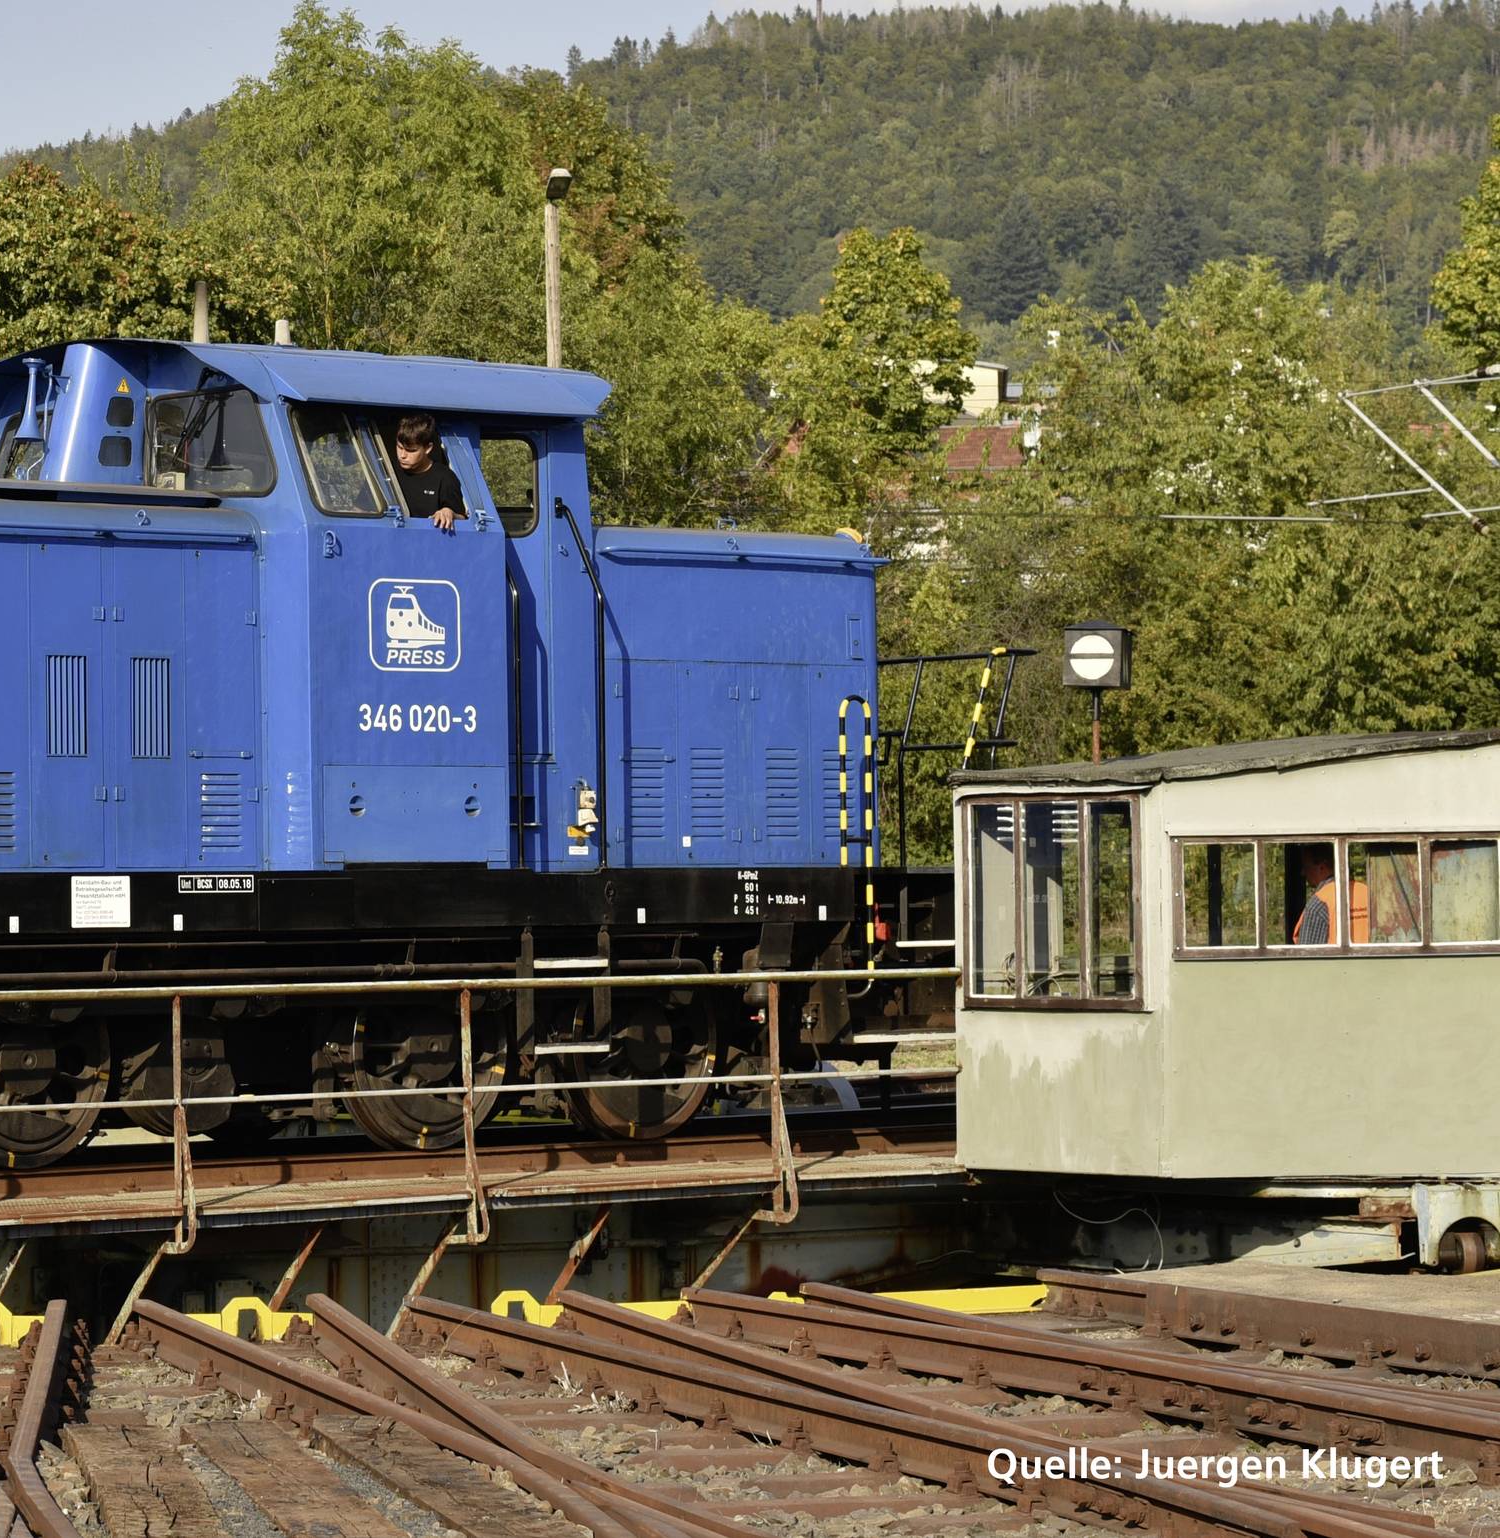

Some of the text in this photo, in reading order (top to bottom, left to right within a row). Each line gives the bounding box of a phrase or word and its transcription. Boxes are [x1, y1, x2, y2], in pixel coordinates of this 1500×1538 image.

[386, 649, 446, 665] PRESS
[359, 703, 477, 733] 346 020-3
[218, 878, 252, 889] 08.05.18
[744, 882, 759, 892] 60 t
[733, 893, 759, 904] P 56 t
[744, 905, 755, 915] 45
[755, 906, 759, 915] t
